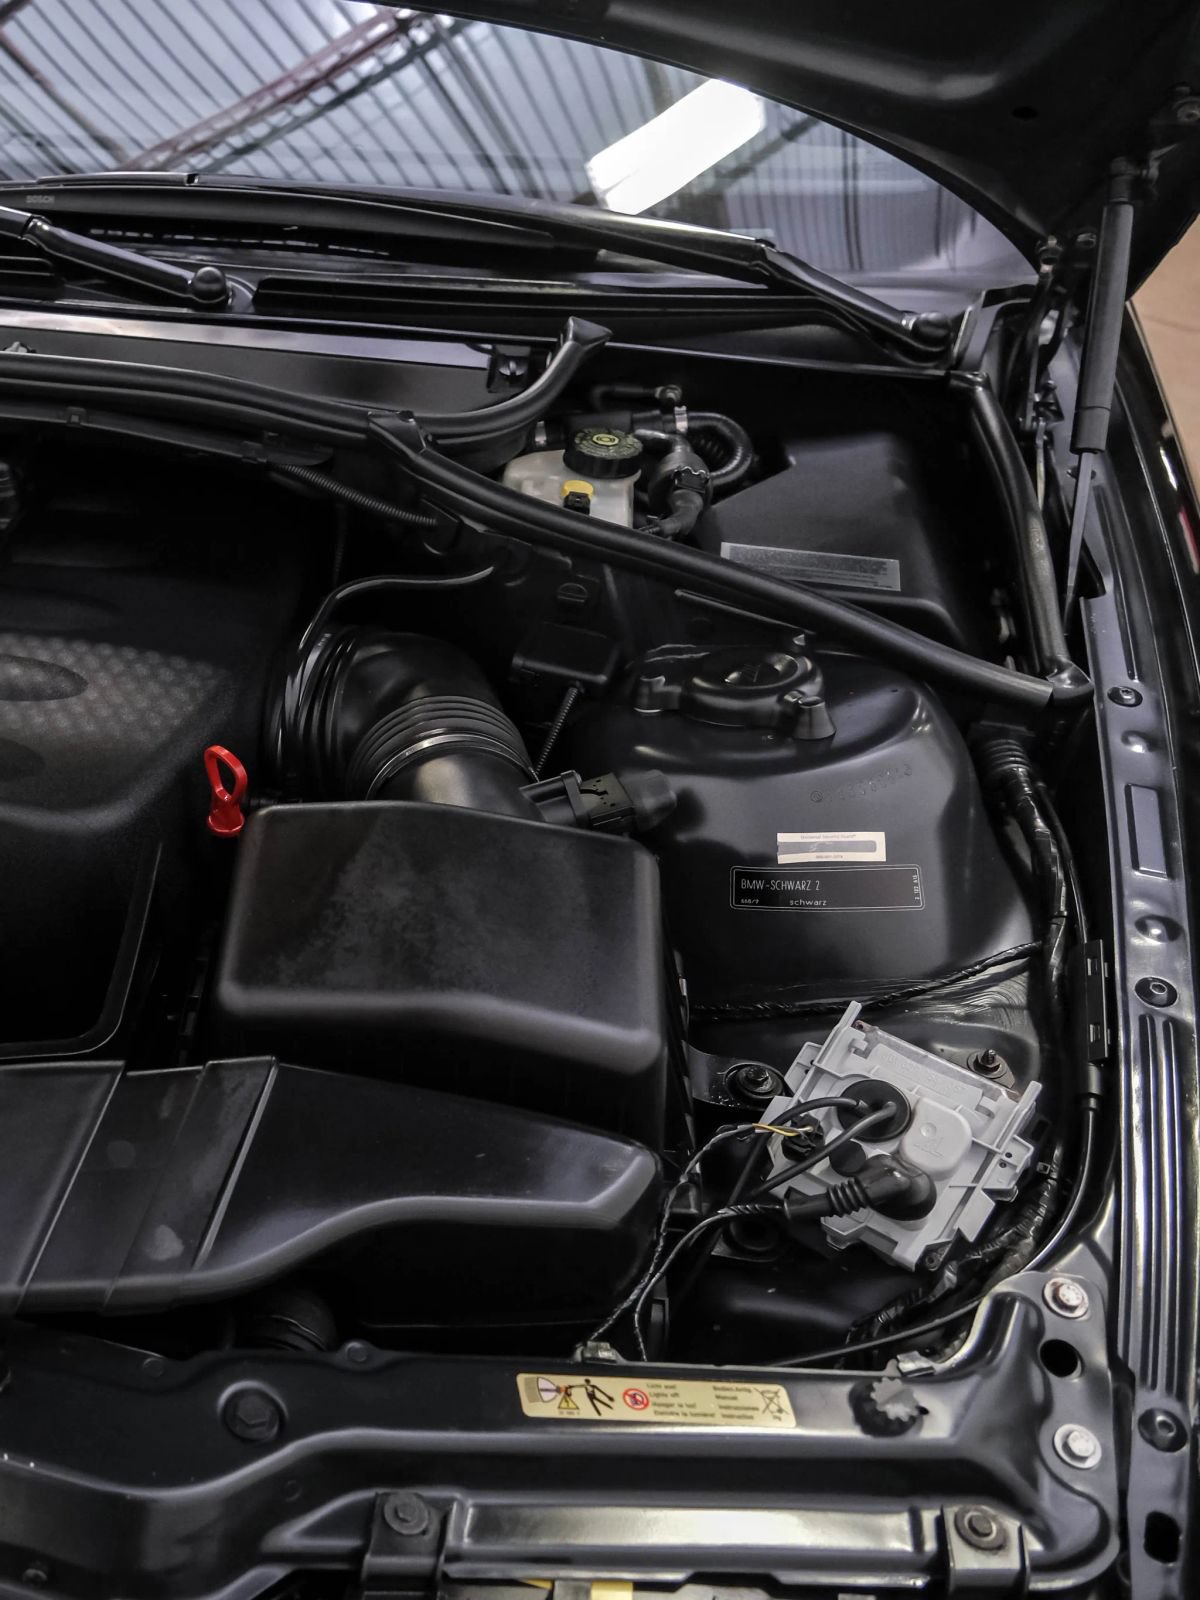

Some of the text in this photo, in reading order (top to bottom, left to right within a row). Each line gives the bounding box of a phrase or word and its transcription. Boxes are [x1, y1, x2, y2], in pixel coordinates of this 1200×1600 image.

[26, 195, 55, 204] BOSCH
[741, 879, 820, 891] BMW-SCHWARZ 2
